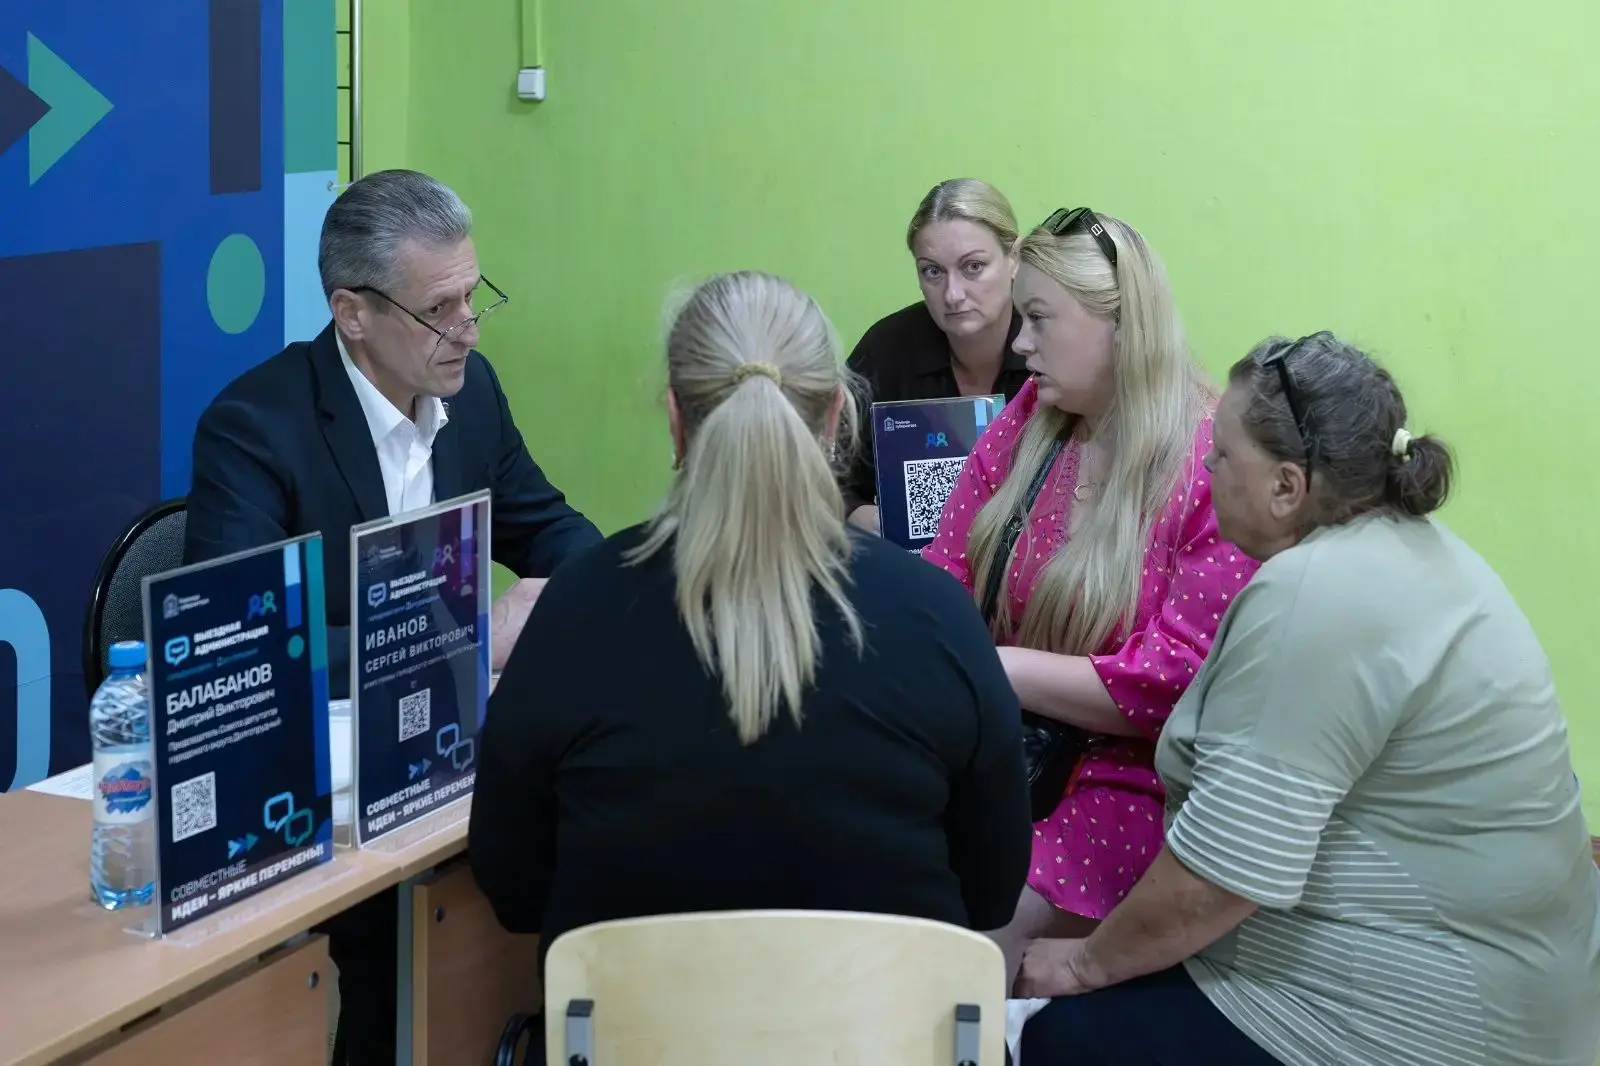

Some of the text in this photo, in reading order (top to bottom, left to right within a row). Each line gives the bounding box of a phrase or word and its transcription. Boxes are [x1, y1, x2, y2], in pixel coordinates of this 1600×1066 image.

[194, 625, 269, 656] АДМИНИСТРАЦИЯ
[365, 615, 428, 651] ИВАНОВ
[365, 624, 474, 673] СЕРГЕЙ ВИКТОРОВИЧ
[166, 663, 272, 715] БАЛАБАНОВ
[167, 688, 276, 735] Дмитрий Викторович
[366, 778, 432, 816] СОВМЕСТНЫЕ
[367, 810, 397, 833] ИДЕИ
[403, 792, 434, 817] ЯРКИЕ
[434, 772, 477, 802] ПЕРЕМЕН
[171, 859, 247, 902] СОВМЕСТНЫЕ
[171, 893, 209, 921] ИДЕИ
[218, 872, 258, 901] ЯРКИЕ
[259, 843, 325, 882] ПЕРЕМЕНЫ!
